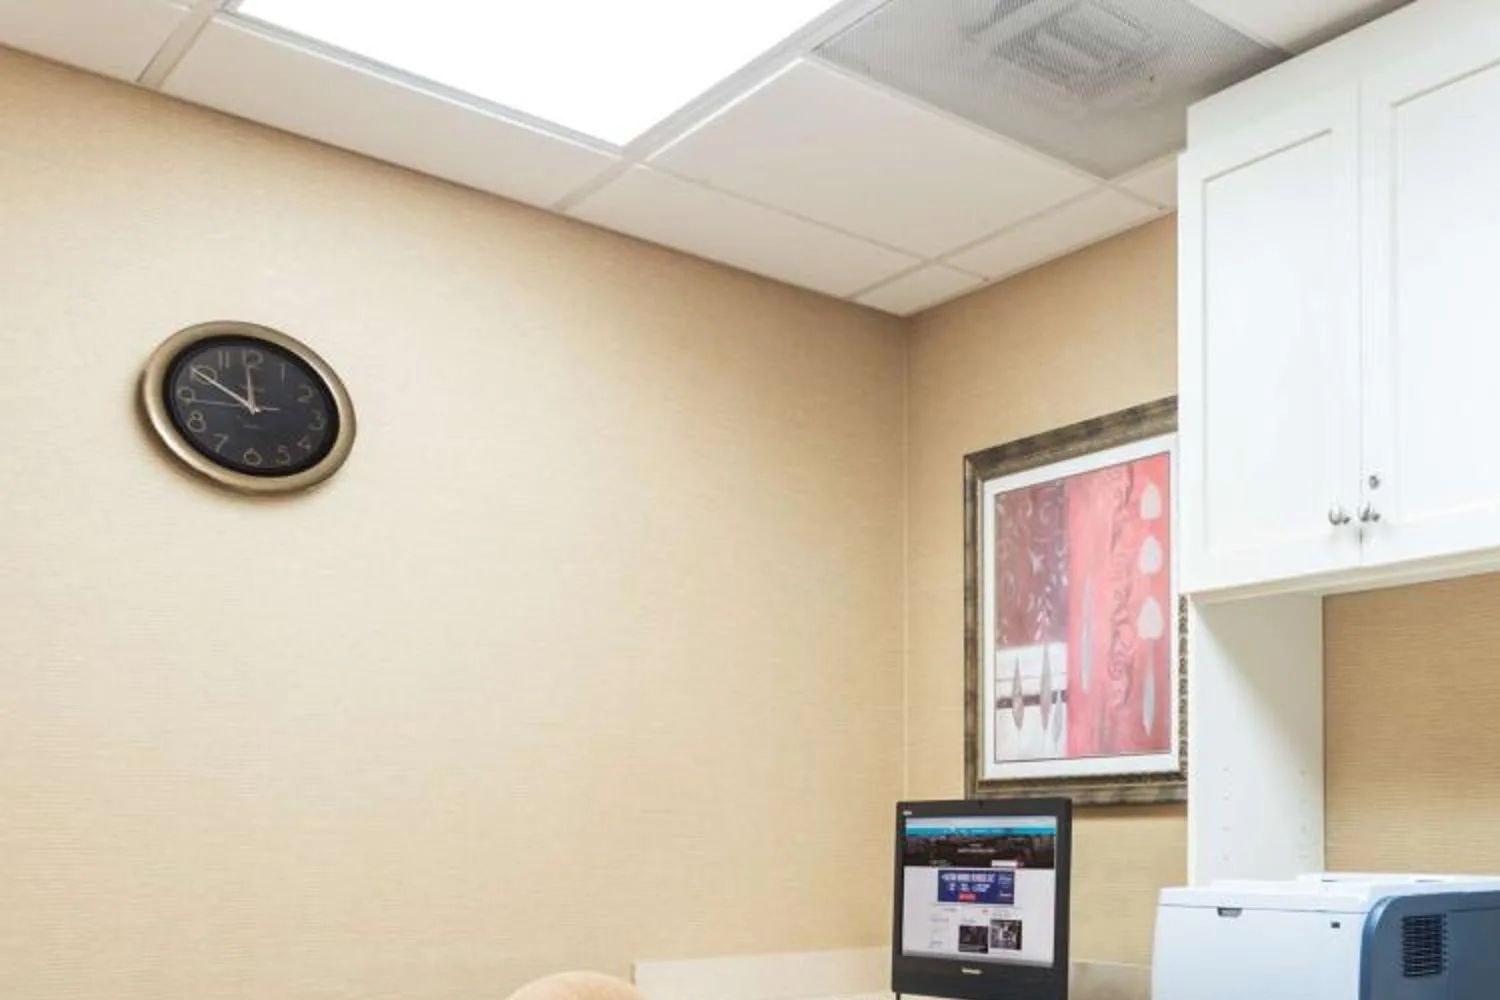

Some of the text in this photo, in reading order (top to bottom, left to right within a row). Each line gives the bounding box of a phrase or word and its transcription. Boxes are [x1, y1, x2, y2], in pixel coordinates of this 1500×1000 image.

[218, 350, 231, 370] 11
[176, 386, 195, 402] 9
[297, 385, 313, 402] 2
[187, 410, 206, 432] 8
[309, 411, 326, 431] 3
[212, 433, 229, 452] 7
[297, 434, 312, 450] 4
[243, 447, 262, 466] 6
[276, 445, 291, 465] 5
